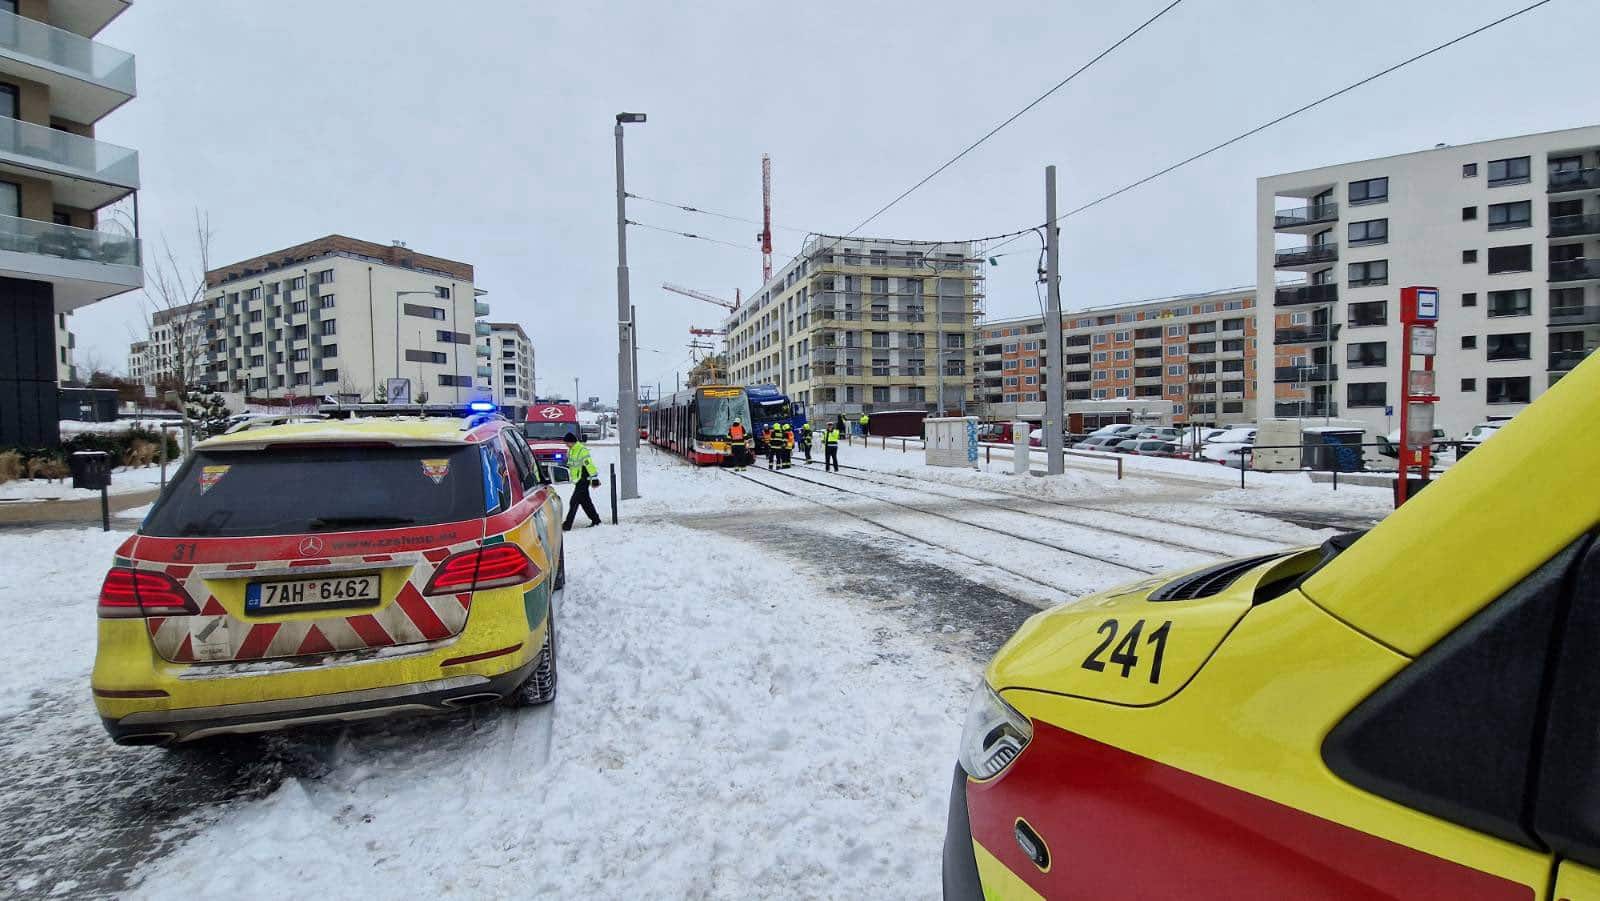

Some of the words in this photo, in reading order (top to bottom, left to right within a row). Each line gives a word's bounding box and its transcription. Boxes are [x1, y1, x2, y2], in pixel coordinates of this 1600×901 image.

[333, 532, 457, 548] www.zzshmp.eu
[173, 544, 197, 560] 31
[266, 584, 305, 604] 7AH
[321, 579, 370, 599] 6462
[1081, 619, 1173, 684] 241
